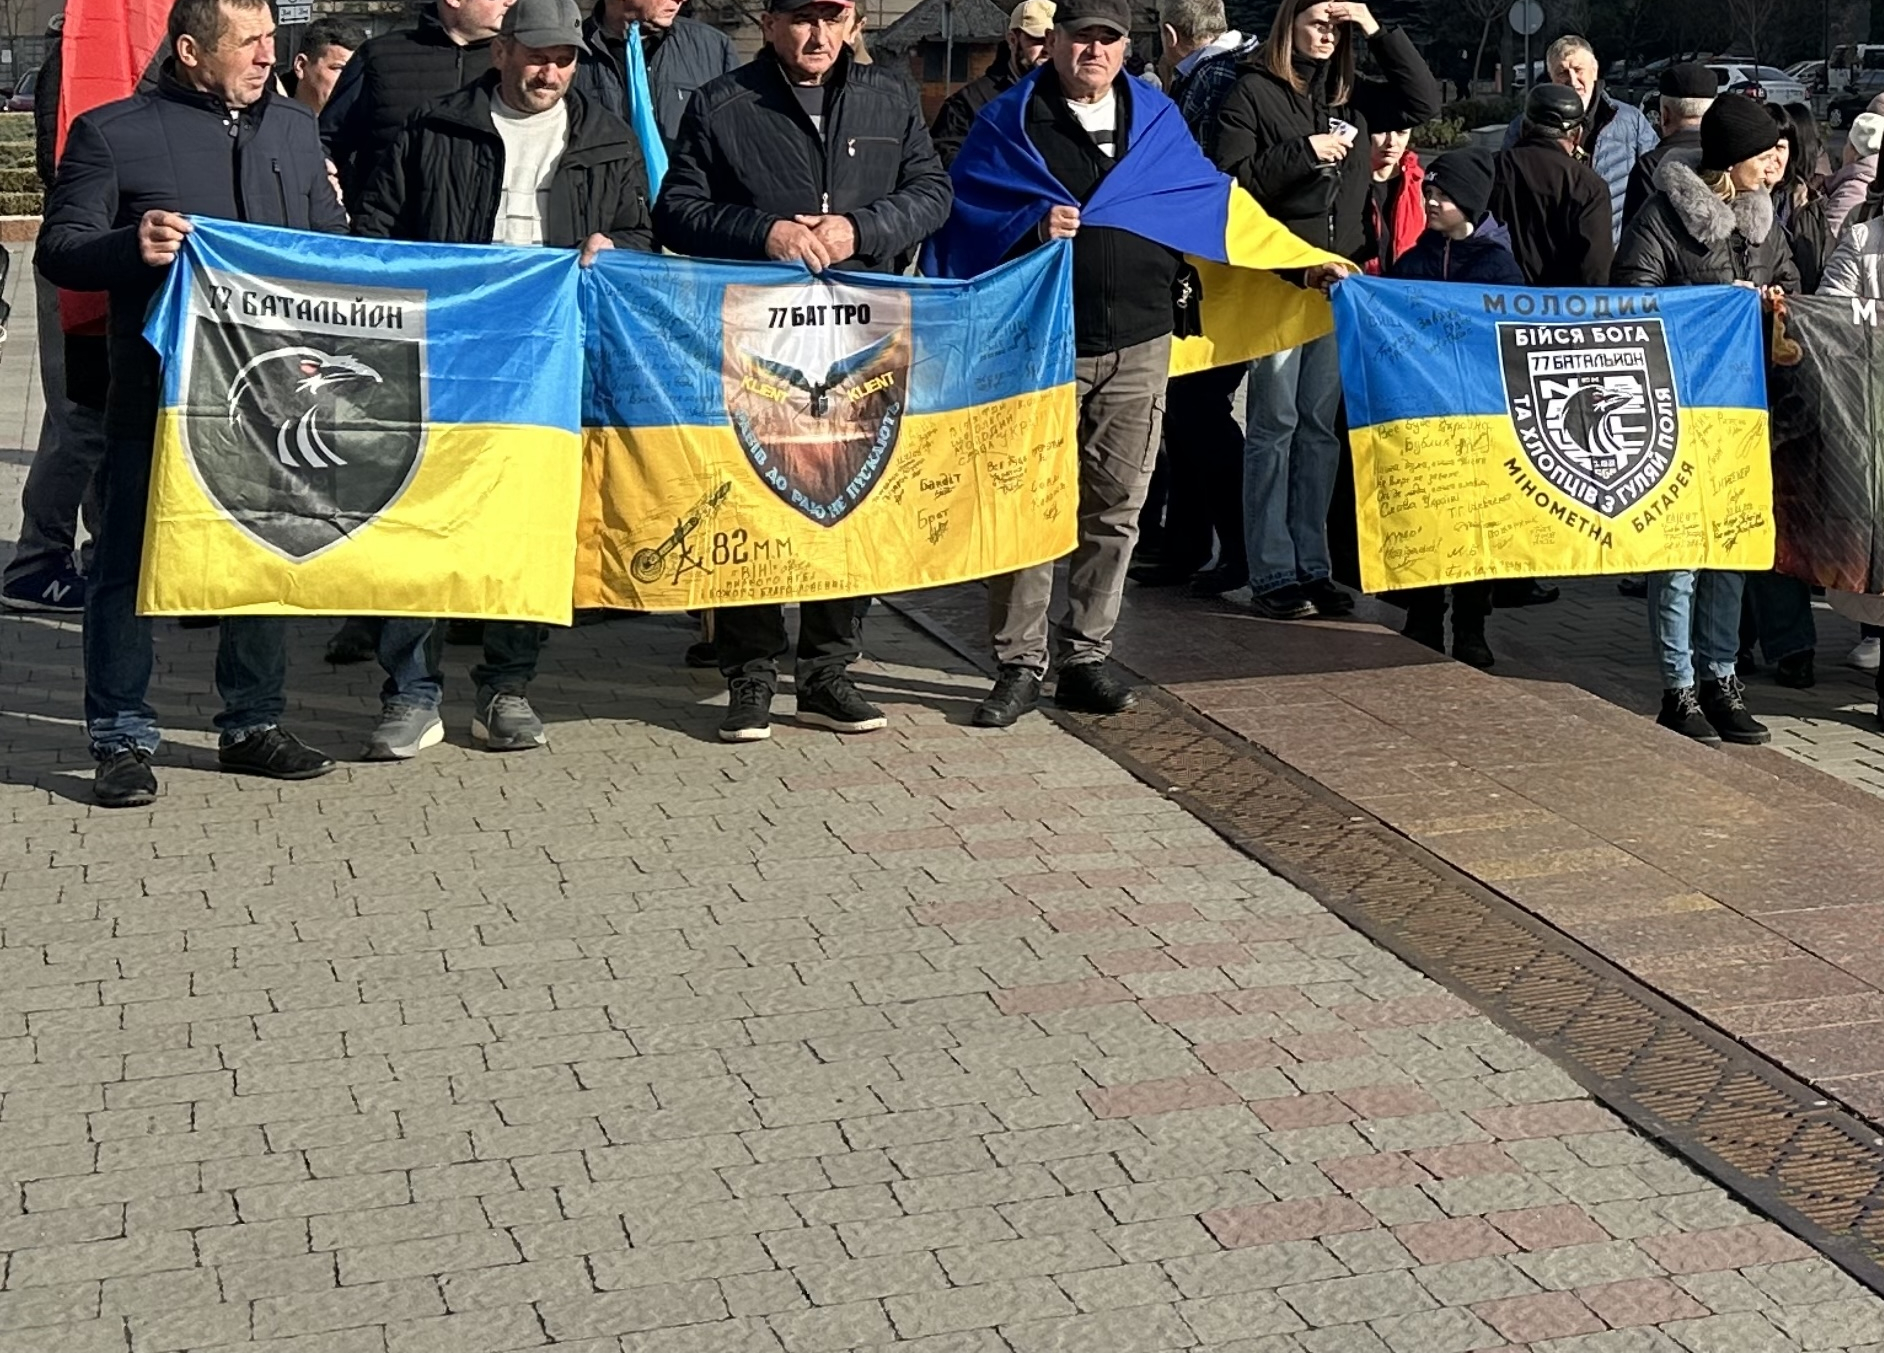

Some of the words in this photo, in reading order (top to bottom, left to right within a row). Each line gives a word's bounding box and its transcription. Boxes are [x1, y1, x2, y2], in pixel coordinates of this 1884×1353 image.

[208, 285, 232, 310] 77
[242, 291, 403, 329] БАТАЛЬЙОН
[768, 307, 788, 329] 77
[791, 305, 827, 327] БАТ
[831, 303, 871, 326] ТРО
[1483, 292, 1661, 318] МОЛОДИЙ
[1514, 326, 1585, 346] БІЙСЯ
[1591, 325, 1650, 343] БОГА
[1531, 356, 1549, 371] 77
[1552, 351, 1645, 371] БАТАЛЬЙОН
[741, 376, 789, 404] KLIENT
[847, 371, 896, 403] KLIENT
[1513, 393, 1533, 421] ТА
[1654, 386, 1676, 450] ПОЛЯ
[1519, 427, 1599, 504] ХЛОПЦІВ
[1614, 450, 1668, 506] ГУЛЯЙ
[1503, 457, 1613, 549] МІНОМЕТНА
[1631, 460, 1695, 534] БАТАРЕЯ
[712, 528, 749, 566] 82
[41, 579, 72, 603] N
